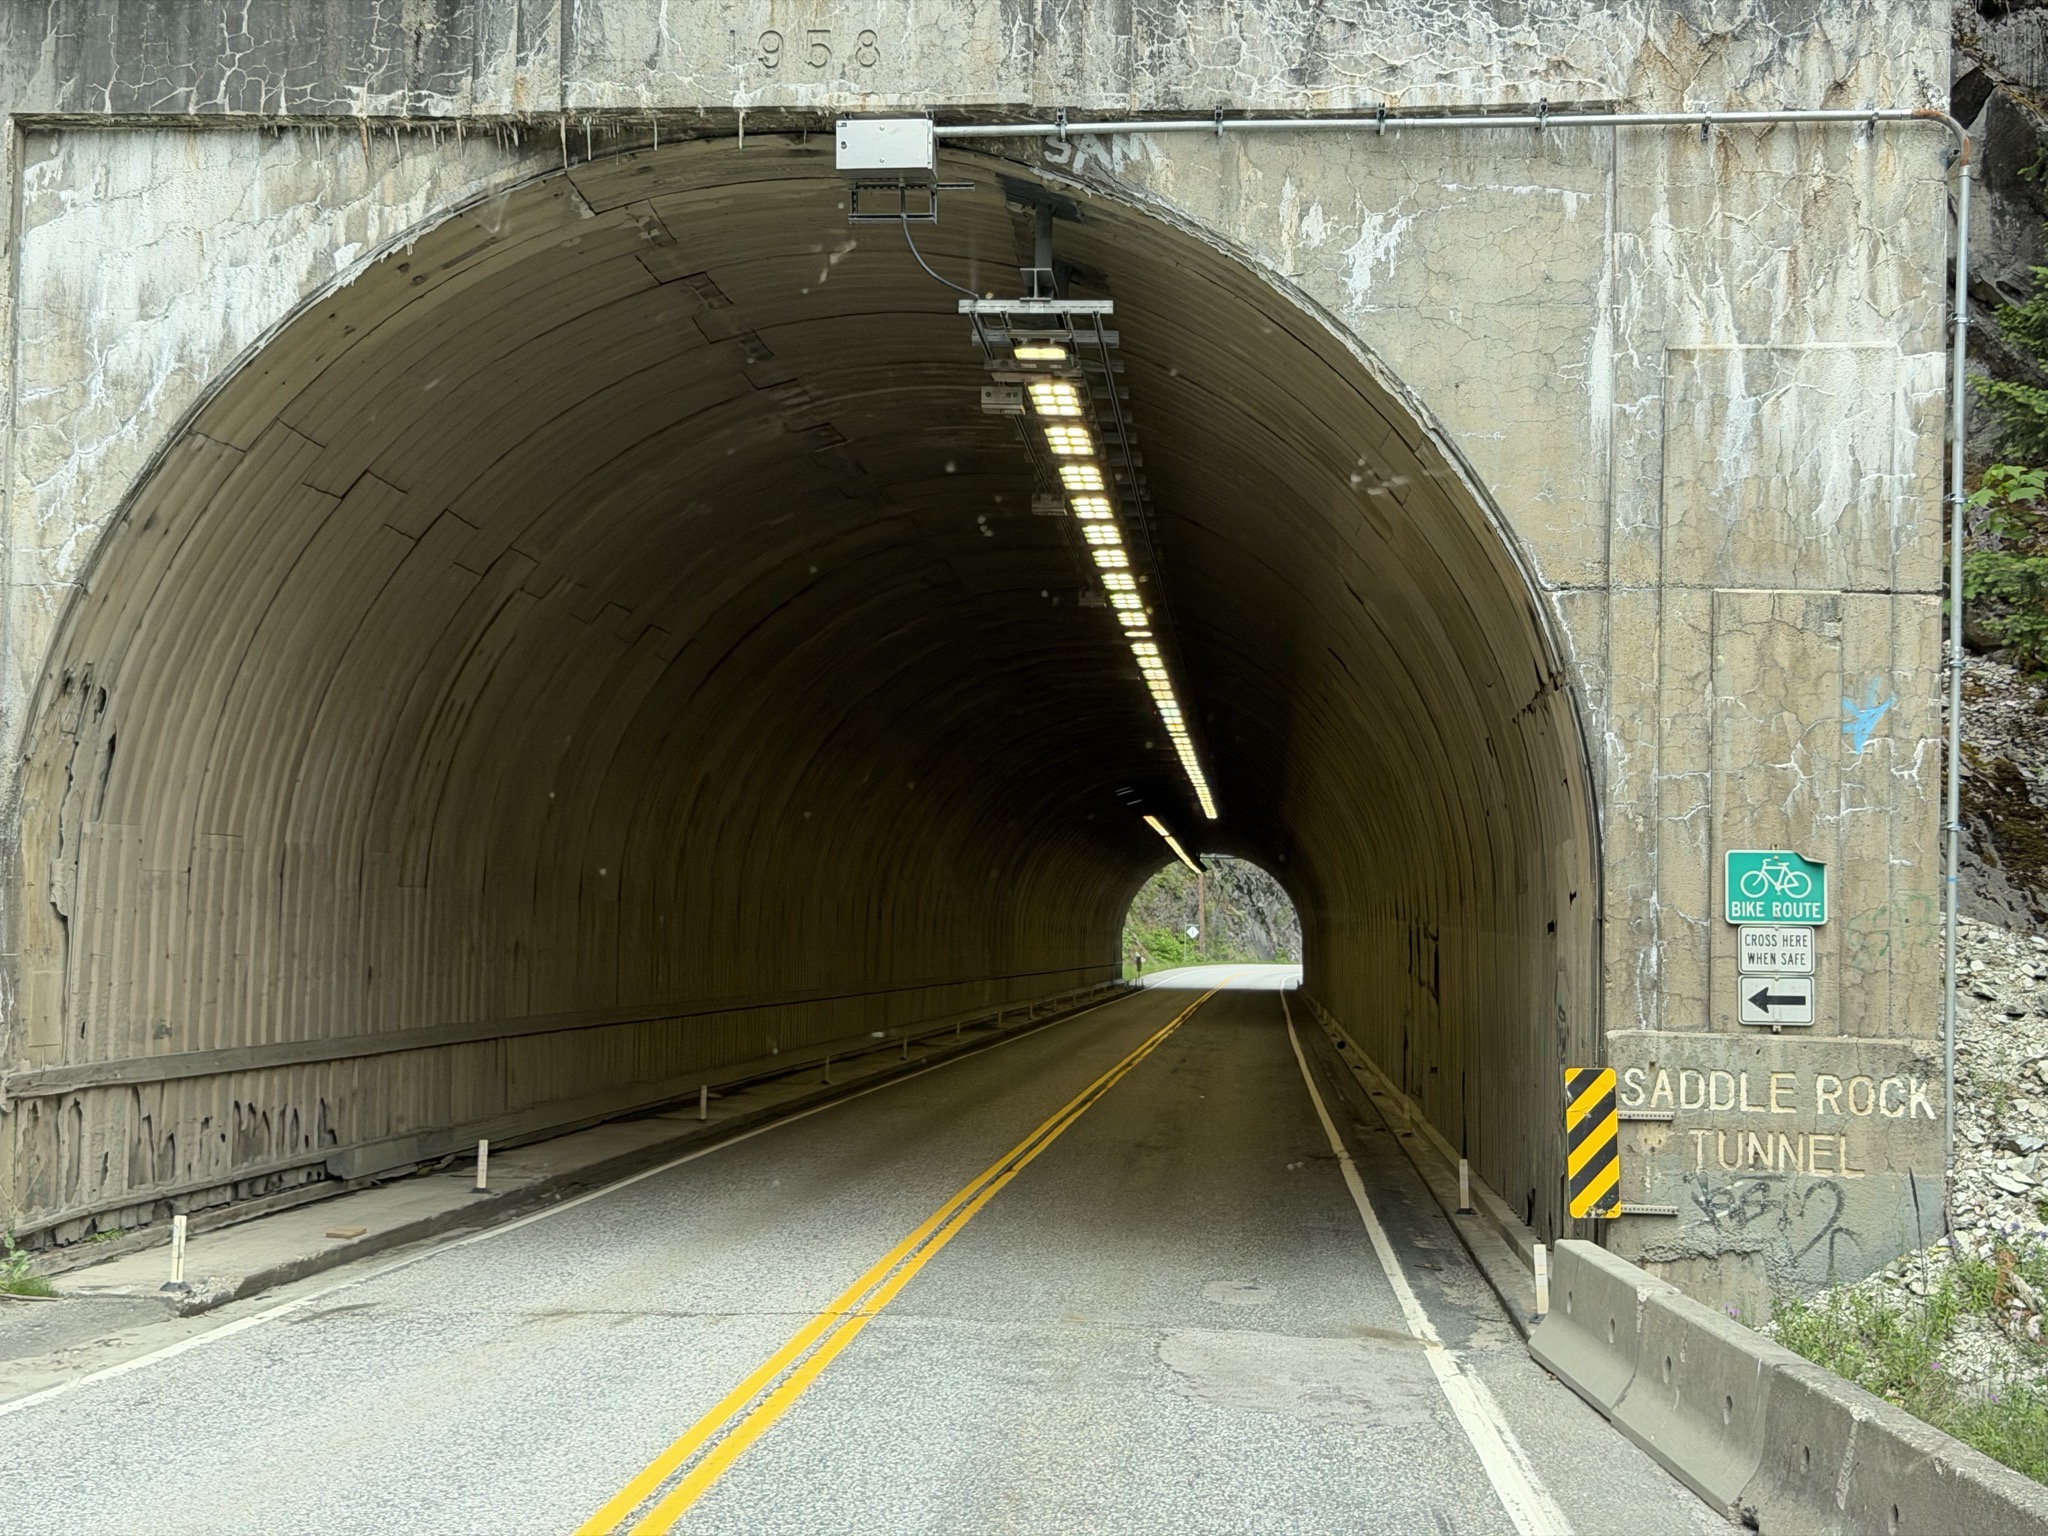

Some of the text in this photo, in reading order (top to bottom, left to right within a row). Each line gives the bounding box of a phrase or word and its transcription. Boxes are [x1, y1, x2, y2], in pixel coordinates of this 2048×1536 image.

[729, 28, 881, 69] 1958
[1731, 901, 1822, 918] BIKE ROUTE
[1744, 934, 1808, 948] CROSS HERE
[1747, 952, 1807, 966] WHEN SAFE
[1620, 1066, 1936, 1119] SADDLE ROCK
[1687, 1127, 1866, 1178] TUNNEL
